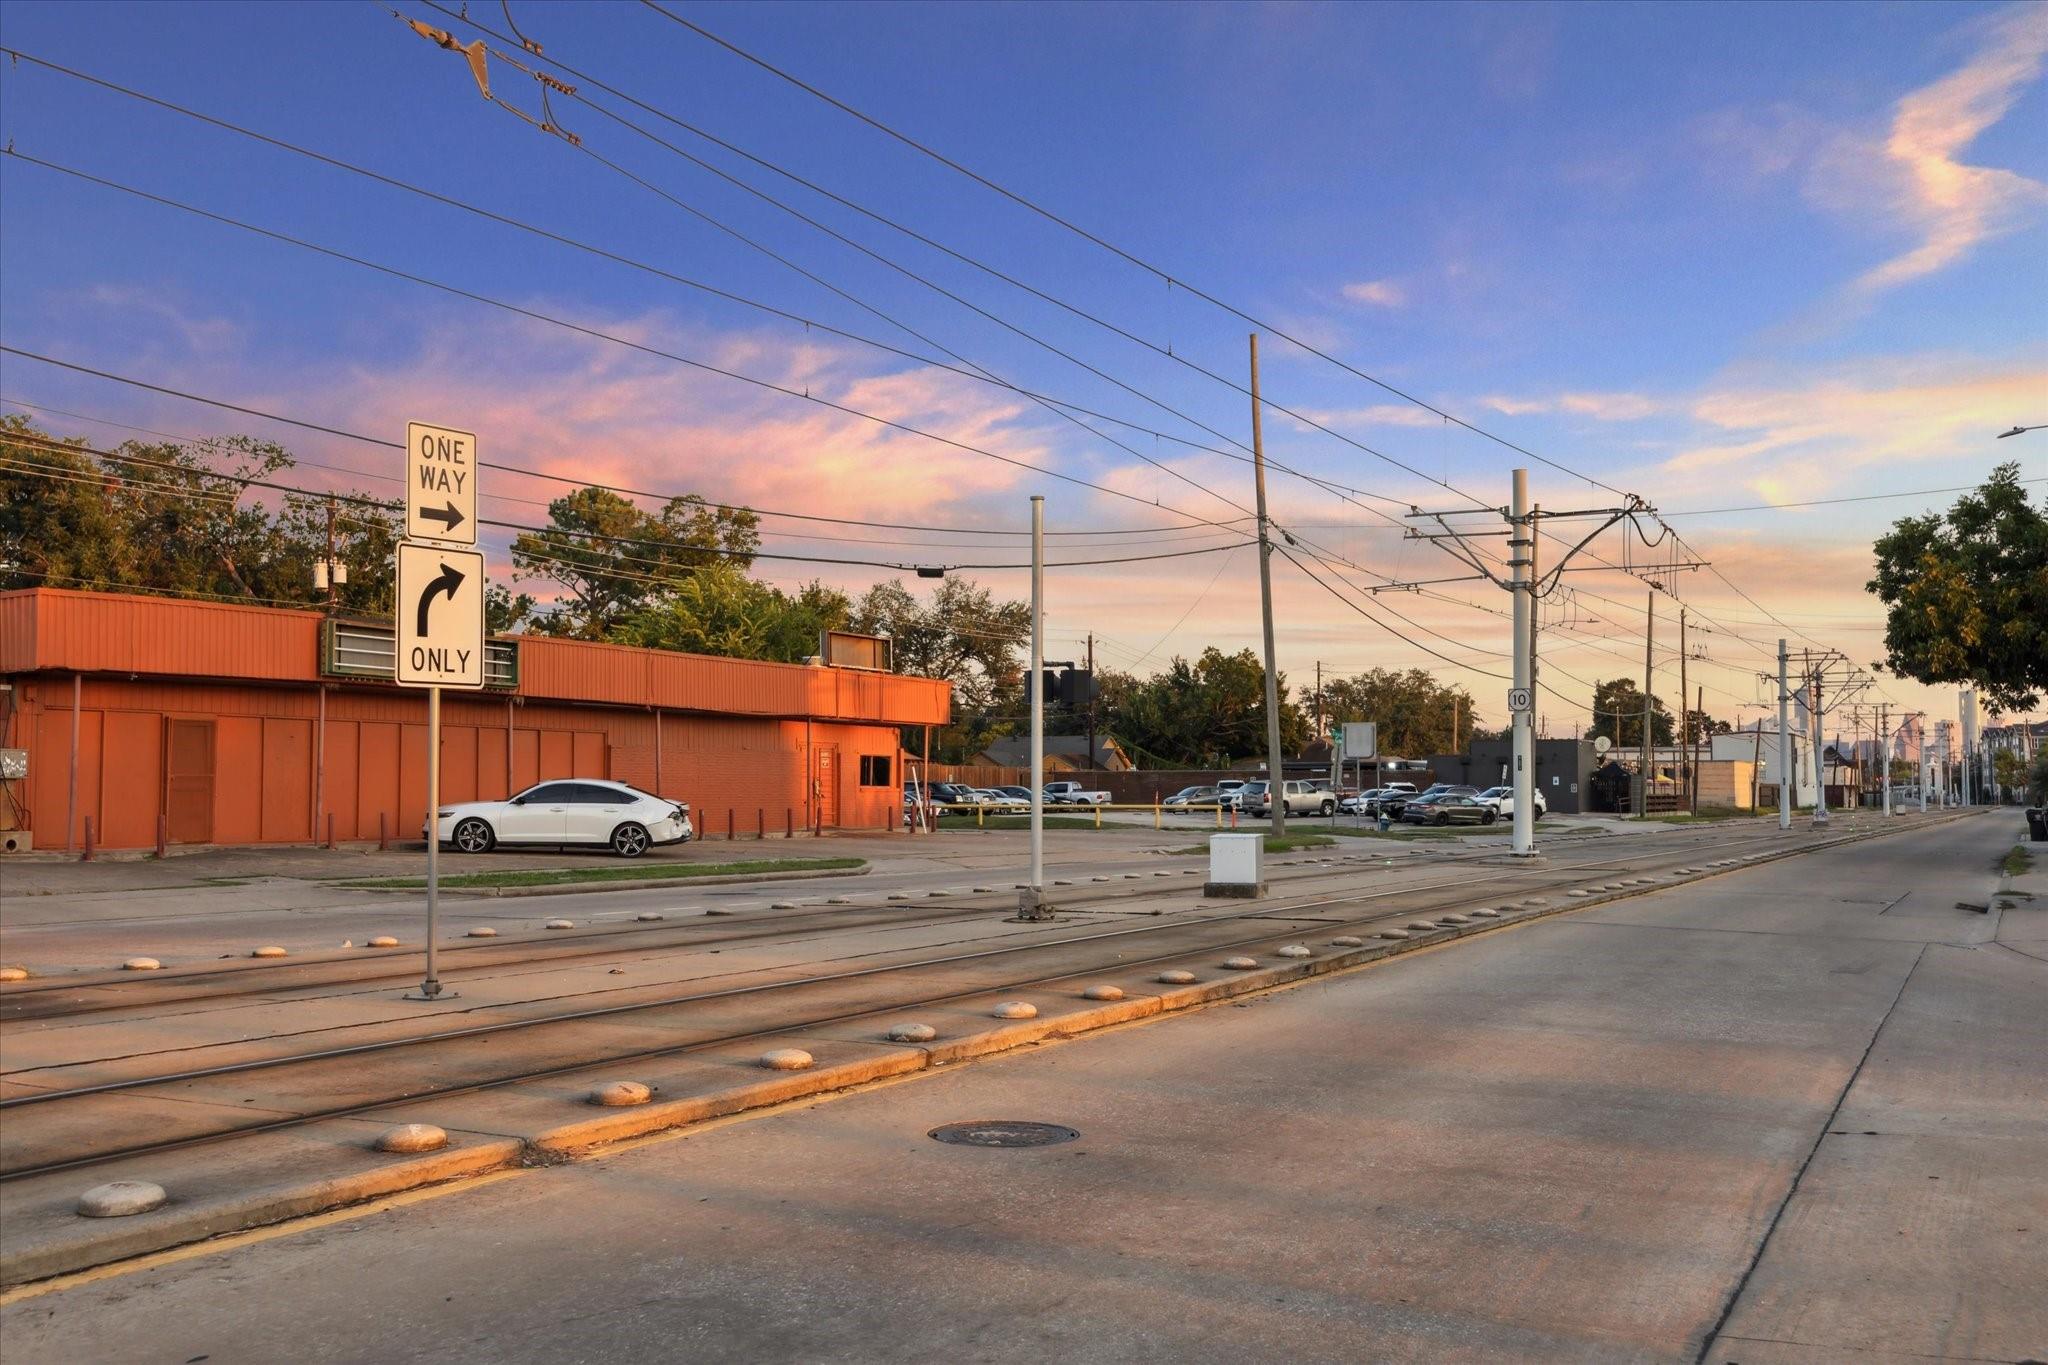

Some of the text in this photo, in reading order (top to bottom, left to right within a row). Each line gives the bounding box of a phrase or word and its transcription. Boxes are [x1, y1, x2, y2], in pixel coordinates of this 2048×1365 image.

[421, 434, 465, 465] ONE
[419, 464, 466, 495] WAY
[411, 646, 471, 674] ONLY
[1513, 694, 1526, 705] 10
